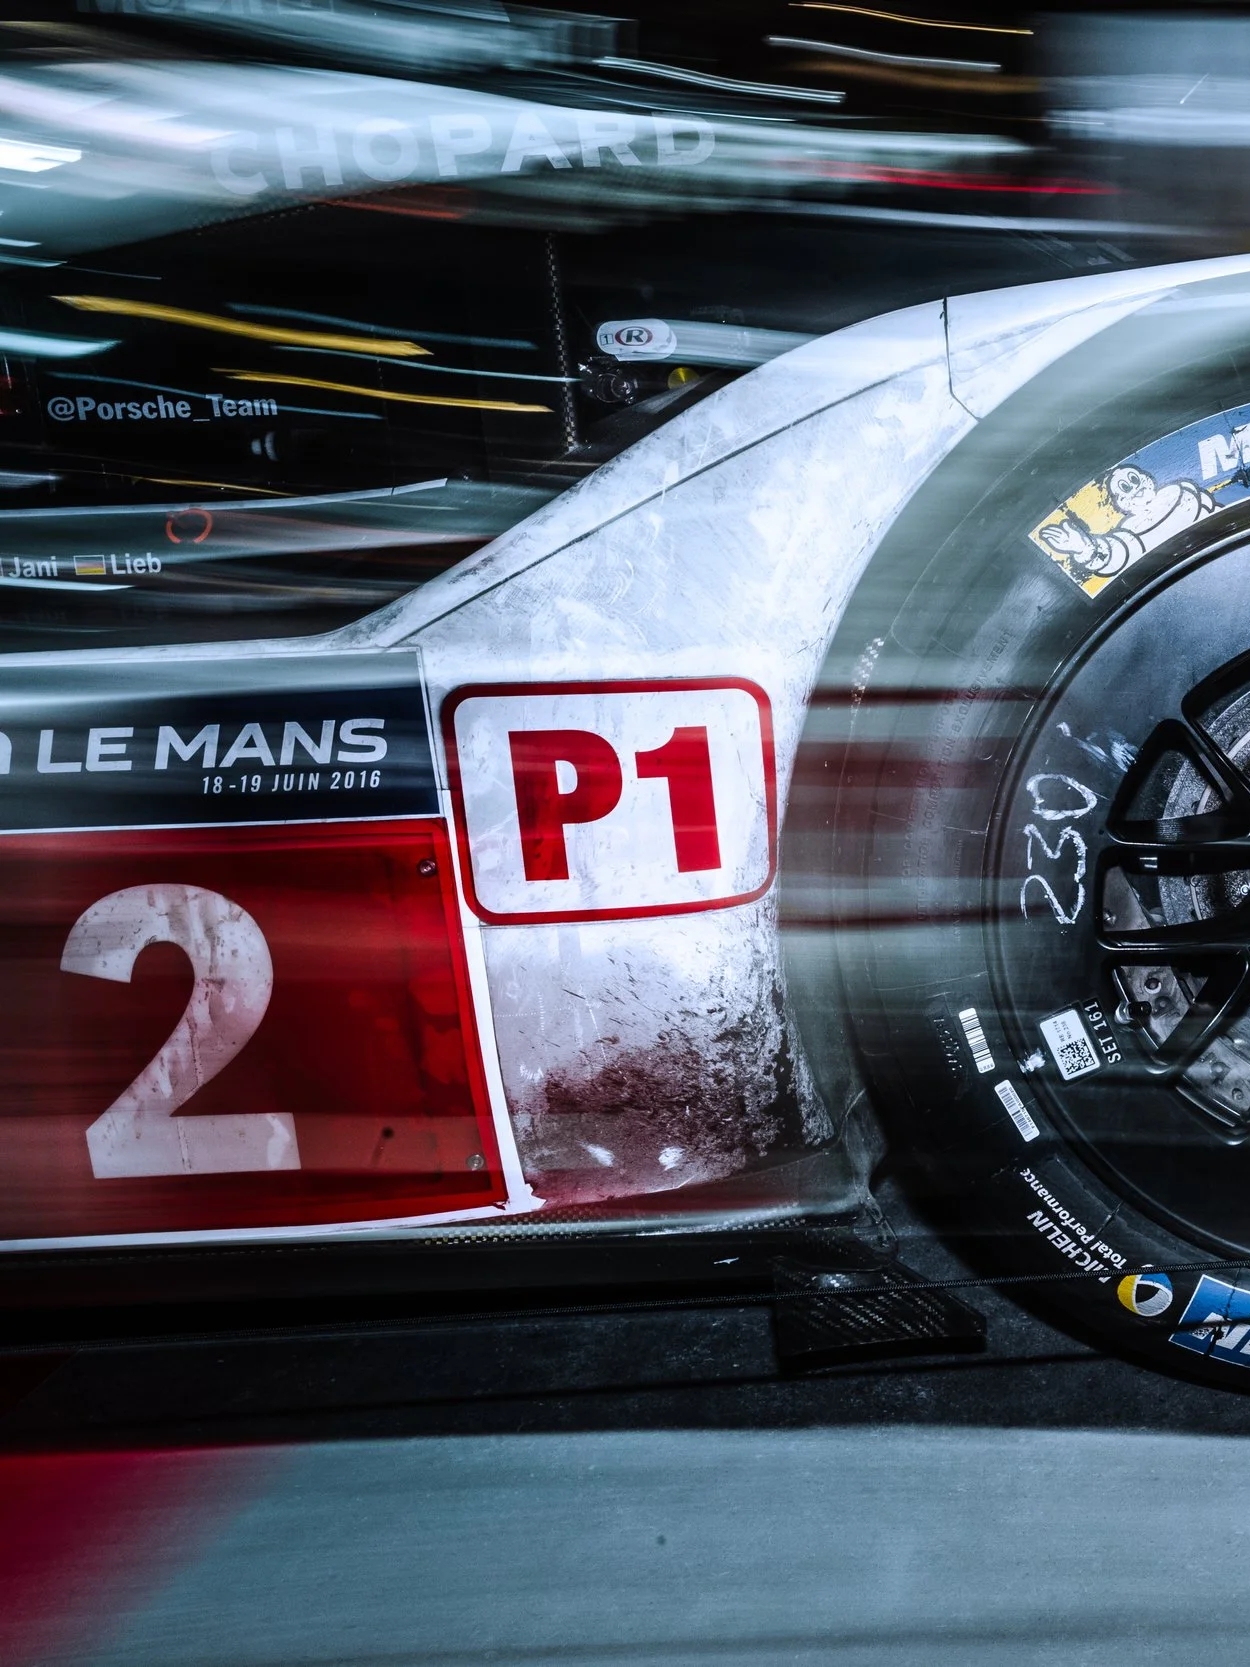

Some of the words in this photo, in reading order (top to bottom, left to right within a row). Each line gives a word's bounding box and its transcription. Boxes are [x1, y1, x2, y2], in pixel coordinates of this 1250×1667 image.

[209, 112, 716, 195] CHOPARD
[46, 393, 279, 423] @Porsche_Team
[8, 556, 58, 578] Jani
[111, 553, 162, 575] Lieb
[37, 726, 134, 773] LE
[154, 718, 388, 770] MANS
[272, 772, 319, 791] JUIN
[330, 770, 381, 790] 2016
[508, 725, 723, 882] P1
[60, 883, 301, 1179] 2
[1084, 1001, 1107, 1030] 161
[1098, 1036, 1121, 1063] SET
[1020, 1168, 1095, 1244] Performance
[1027, 1210, 1111, 1283] MICHELIN
[1090, 1241, 1127, 1270] Total
